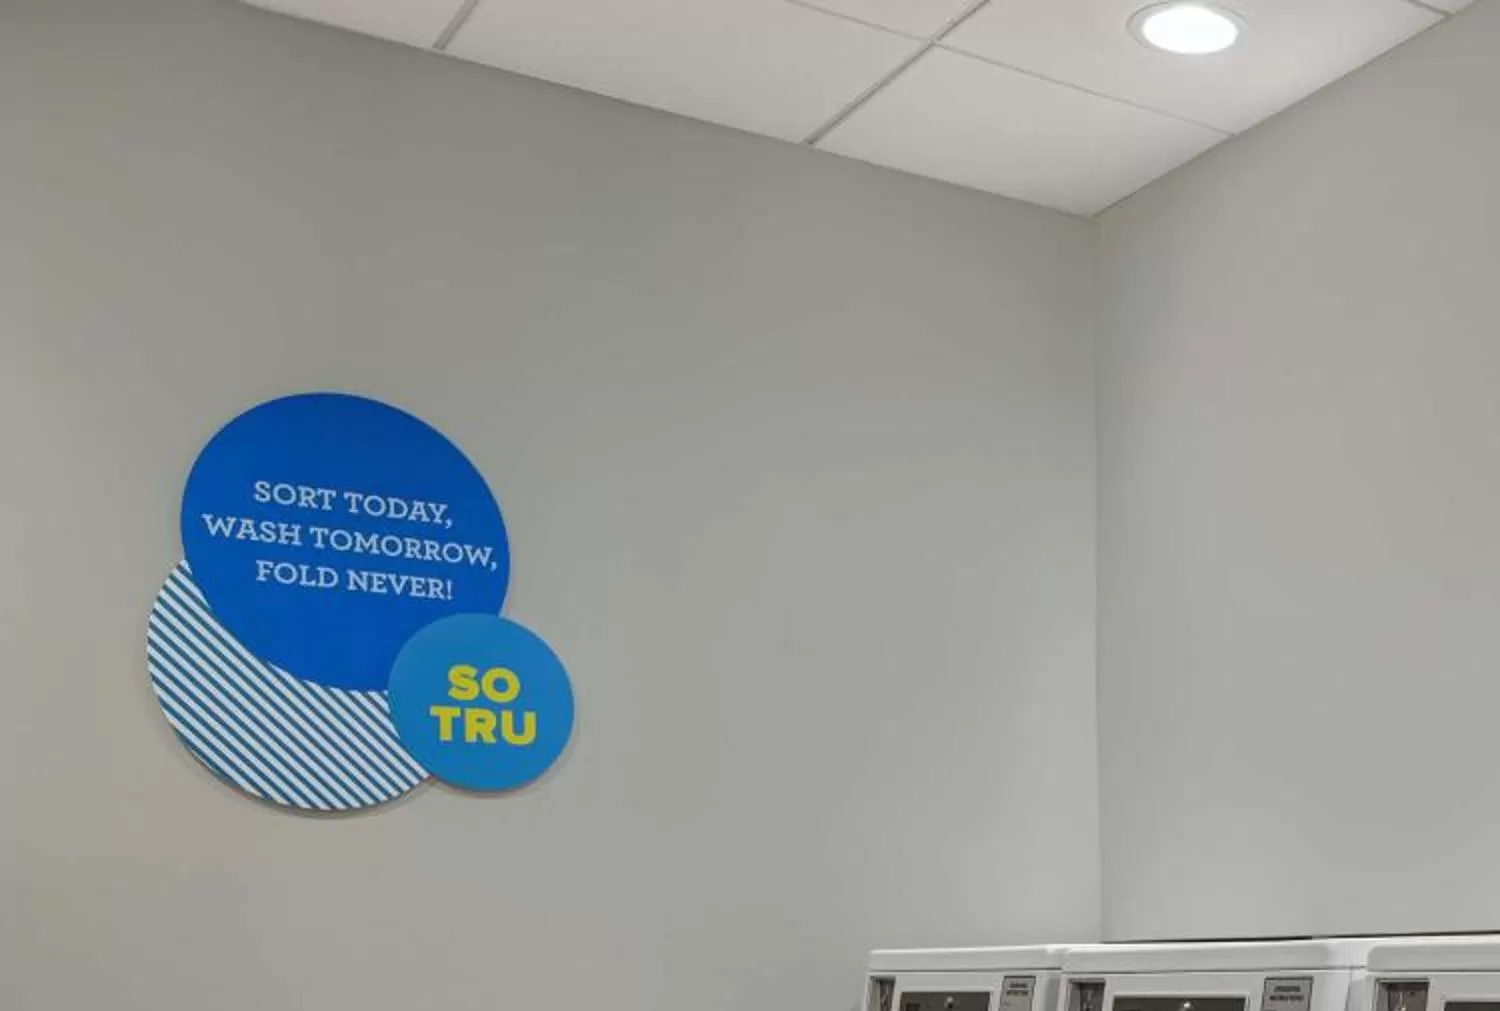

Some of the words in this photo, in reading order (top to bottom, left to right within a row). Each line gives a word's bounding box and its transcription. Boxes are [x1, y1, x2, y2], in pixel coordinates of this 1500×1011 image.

[254, 480, 336, 511] SORT
[343, 491, 453, 529] TODAY,
[201, 513, 302, 546] WASH
[309, 526, 497, 572] TOMORROW,
[255, 559, 339, 588] FOLD
[347, 569, 453, 600] NEVER!
[448, 664, 520, 703] SO
[430, 705, 536, 745] TRU
